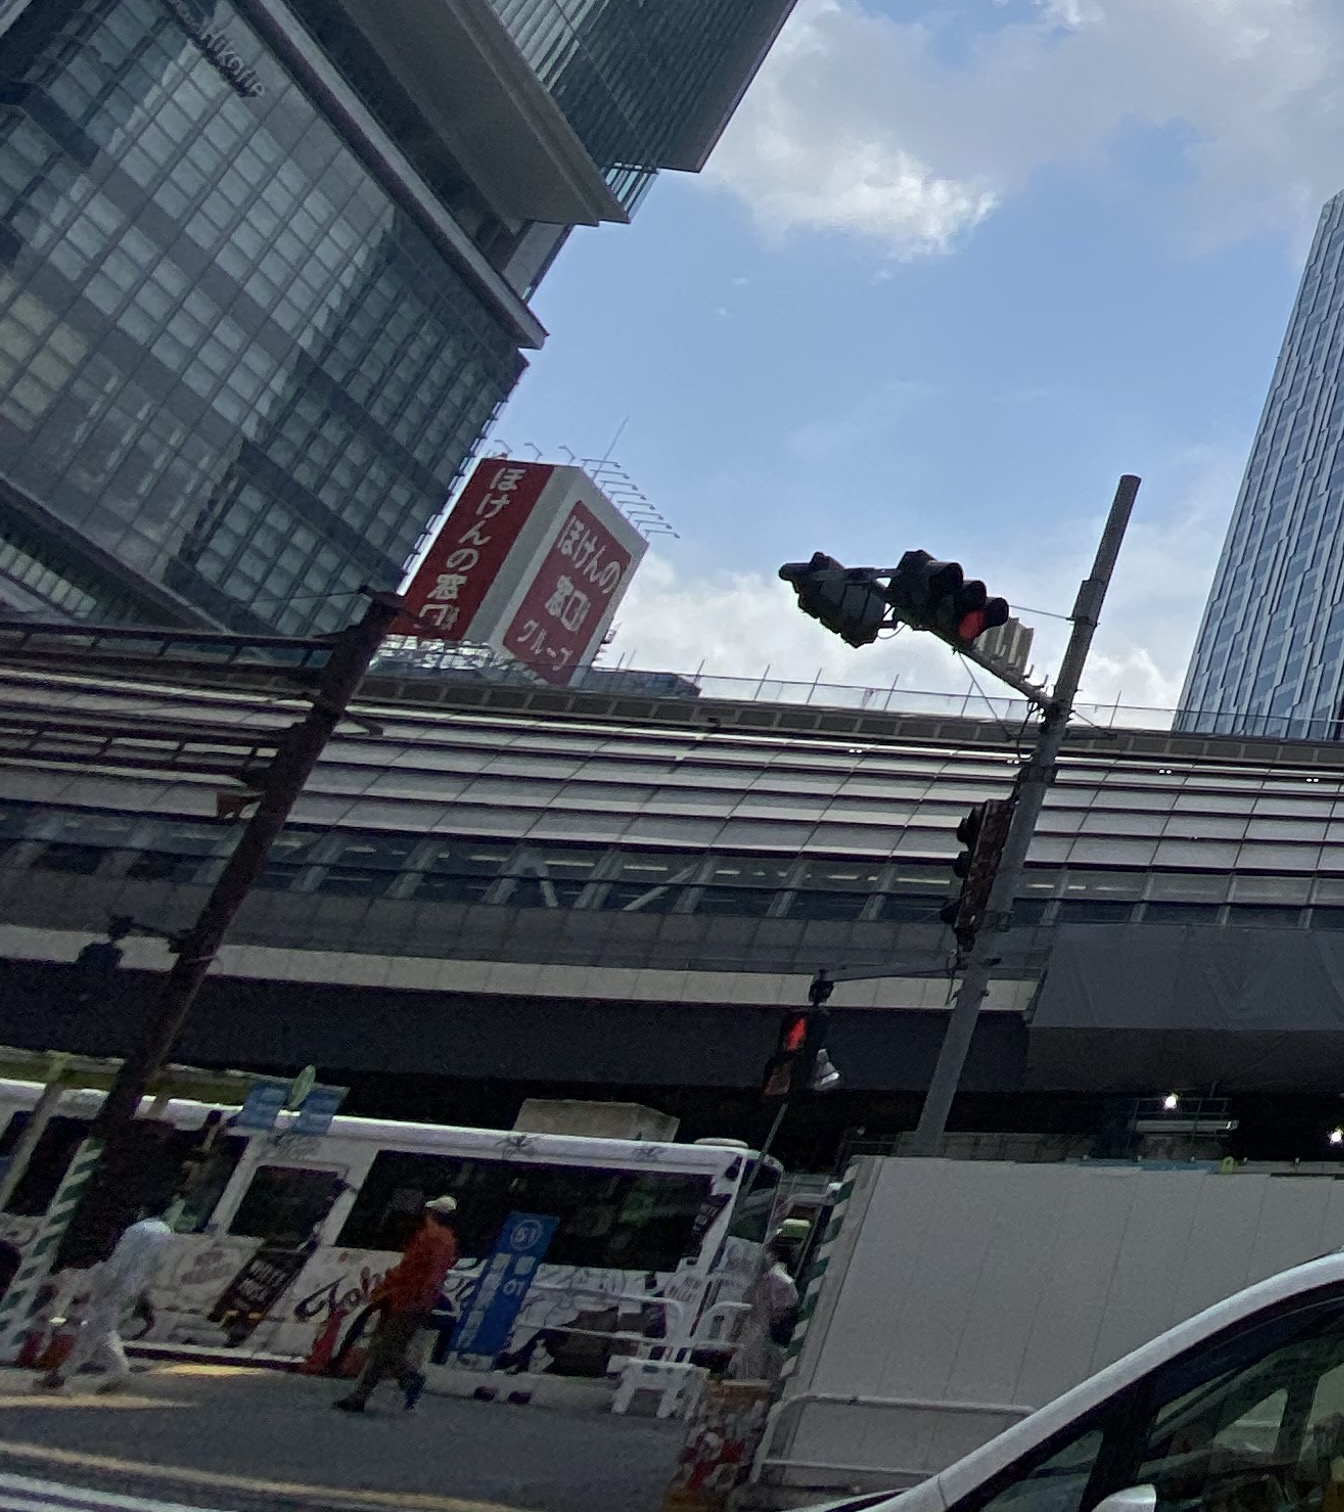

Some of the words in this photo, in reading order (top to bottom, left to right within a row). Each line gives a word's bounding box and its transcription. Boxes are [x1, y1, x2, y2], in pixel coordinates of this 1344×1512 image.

[413, 467, 527, 631] ほけんの窓口
[556, 515, 622, 595] ほけんの
